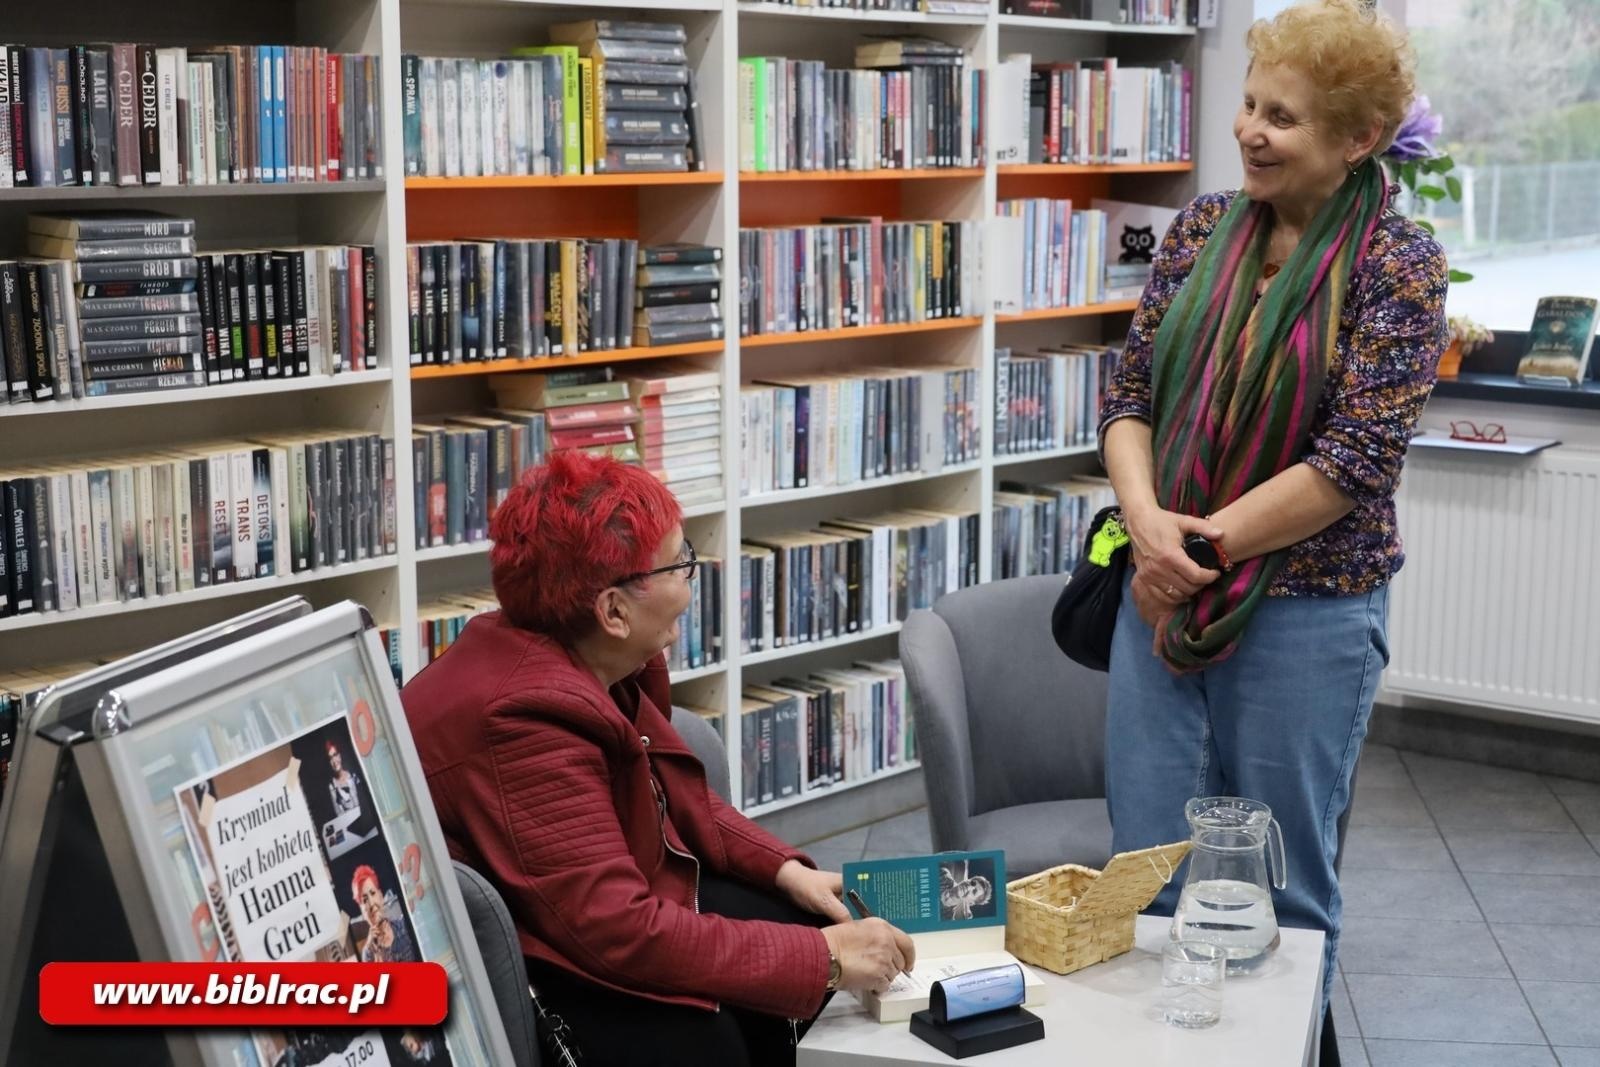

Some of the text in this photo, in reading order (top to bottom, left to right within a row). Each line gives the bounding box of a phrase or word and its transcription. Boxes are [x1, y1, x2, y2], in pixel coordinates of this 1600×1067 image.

[13, 75, 21, 102] BRYNDZA
[56, 84, 70, 114] BUSSI
[93, 70, 107, 108] LALKI
[118, 70, 134, 127] CEDER
[142, 72, 156, 128] CEDER
[405, 78, 416, 116] SPRAWA
[144, 223, 169, 236] MORD
[143, 260, 170, 276] GRÓB
[411, 290, 419, 316] LINK
[425, 290, 433, 316] LINK
[219, 327, 230, 356] WINA
[282, 325, 293, 353] KREW
[309, 317, 319, 345] INNA
[996, 356, 1008, 420] LEGION
[14, 509, 25, 548] ĆWIRLEJ
[34, 483, 46, 539] ĆWIRLEJ
[214, 500, 227, 536] RESET
[237, 498, 250, 543] TRANS
[257, 494, 270, 540] DETOKS
[216, 786, 292, 846] Kryminał
[225, 828, 314, 898] jest kobietą
[240, 864, 316, 924] Hanna
[919, 868, 930, 918] HANNA GREŃ
[264, 902, 320, 961] Greń
[345, 1040, 374, 1067] 17.00
